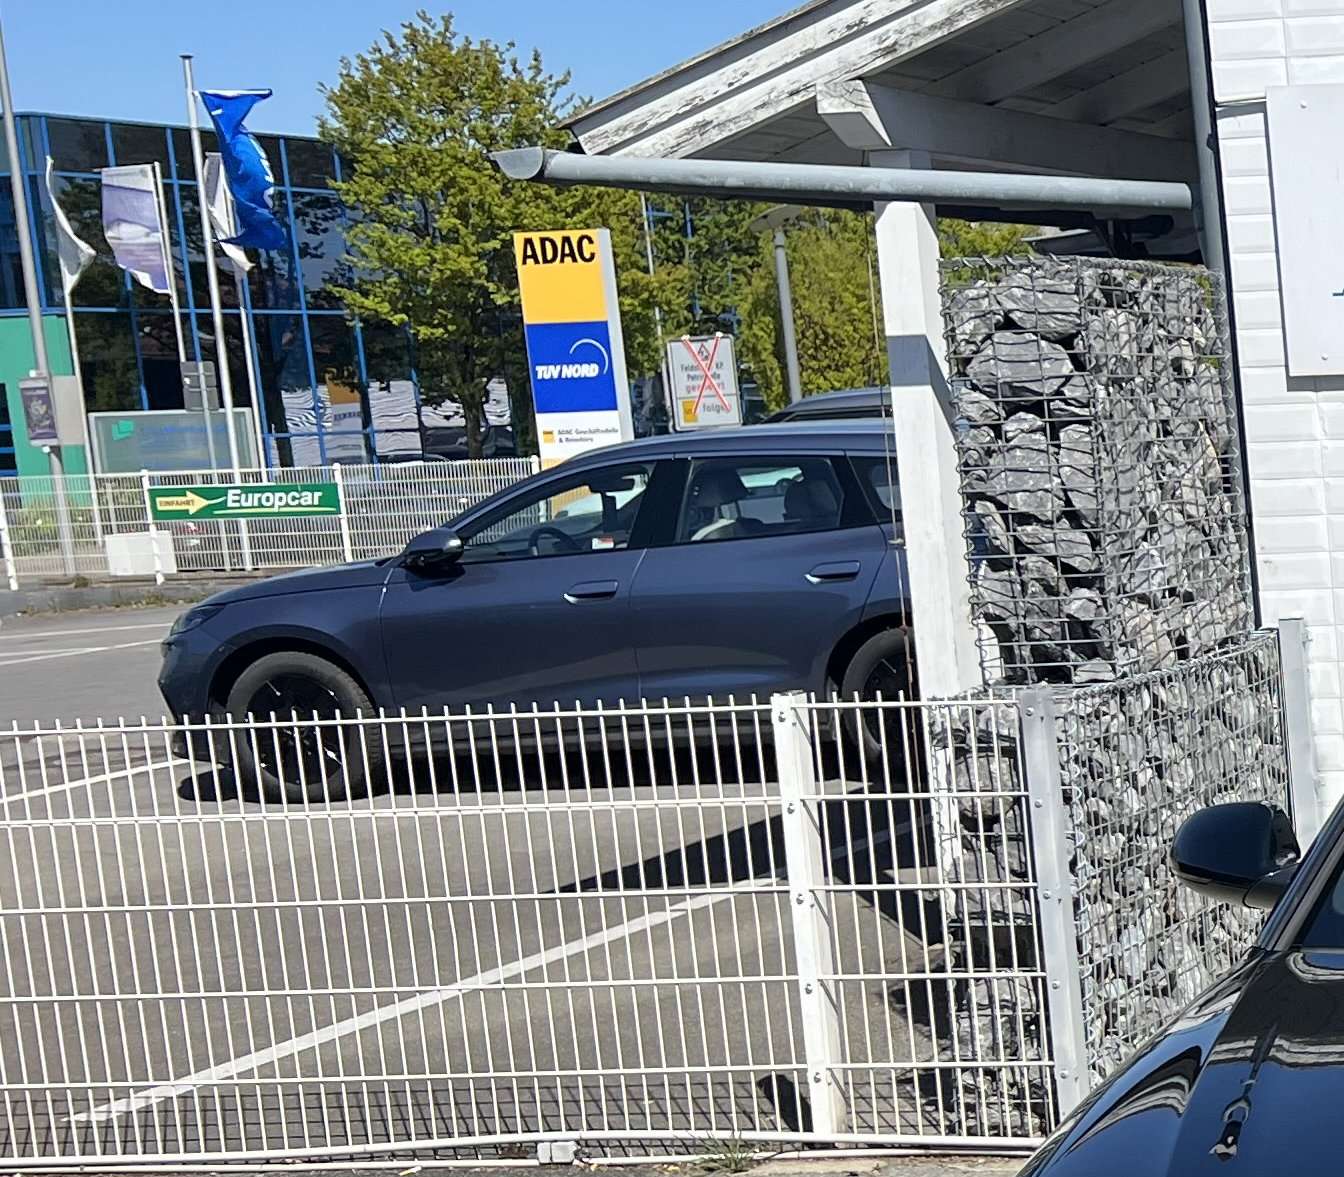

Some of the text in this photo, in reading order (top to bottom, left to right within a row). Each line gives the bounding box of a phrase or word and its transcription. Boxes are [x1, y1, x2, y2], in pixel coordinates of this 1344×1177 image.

[522, 234, 596, 265] ADAC
[561, 363, 599, 379] NORD
[226, 489, 323, 512] Europcar
